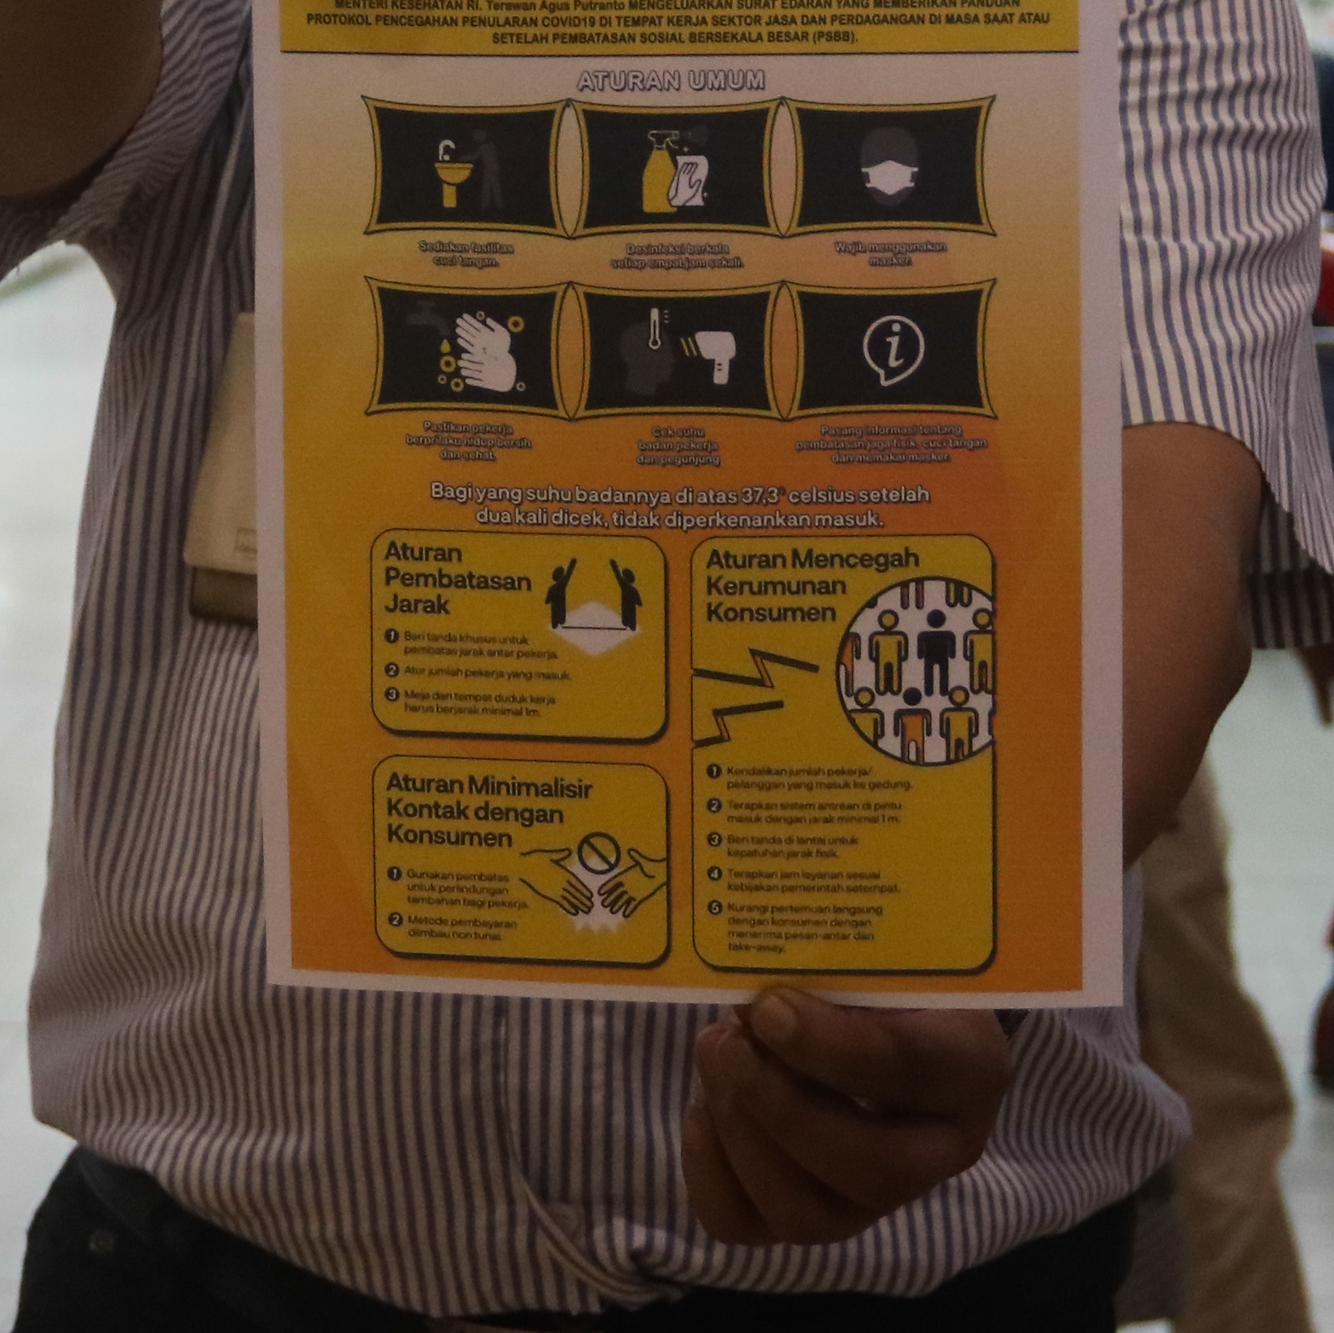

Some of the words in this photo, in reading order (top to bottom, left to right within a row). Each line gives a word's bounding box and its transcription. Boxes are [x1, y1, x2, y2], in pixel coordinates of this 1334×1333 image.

[487, 0, 535, 11] Terawan
[541, 0, 569, 12] Agus
[573, 0, 624, 12] Putranto
[628, 0, 732, 12] MENGELUARKAN
[737, 0, 777, 11] SURAT
[307, 13, 370, 26] PROTOKOL
[375, 14, 457, 27] PENCEGAHAN
[462, 15, 537, 27] PENULARAN
[542, 15, 594, 28] COVID19
[600, 16, 610, 28] DI
[615, 16, 665, 28] TEMPAT
[667, 16, 711, 28] KERJA
[713, 16, 760, 28] SEKTOR
[766, 15, 799, 28] JASA
[801, 15, 829, 27] DAN
[831, 14, 924, 27] PERDAGANGAN
[929, 14, 941, 26] DI
[945, 14, 979, 26] MASA
[984, 13, 1013, 26] SAAT
[1019, 12, 1050, 25] ATAU
[493, 32, 547, 44] SETELAH
[553, 32, 635, 45] PEMBATASAN
[639, 32, 685, 45] SOSIAL
[689, 32, 762, 44] BERSEKALA
[767, 32, 808, 44] BESAR
[577, 70, 680, 91] ATURAN
[688, 70, 765, 90] UMUM
[430, 482, 473, 502] Bagi
[475, 483, 523, 503] yang
[527, 484, 572, 503] suhu
[575, 485, 669, 504] badannya
[677, 485, 693, 504] di
[698, 486, 737, 504] atas
[790, 486, 855, 504] celsius
[859, 485, 930, 504] setelah
[477, 508, 511, 527] dua
[515, 509, 547, 527] kali
[613, 510, 660, 529] tidak
[665, 510, 811, 529] diperkenankan
[384, 541, 462, 563] Aturan
[706, 548, 785, 569] Aturan
[791, 547, 919, 572] Mencegah
[384, 566, 532, 591] Pembatasan
[707, 576, 846, 596] Kerumunan
[384, 593, 450, 615] Jarak
[707, 603, 836, 622] Konsumen
[386, 772, 463, 795] Aturan
[468, 774, 592, 799] Minimalisir
[387, 798, 469, 821] Kontak
[475, 801, 564, 827] dengan
[387, 824, 513, 847] Konsumen
